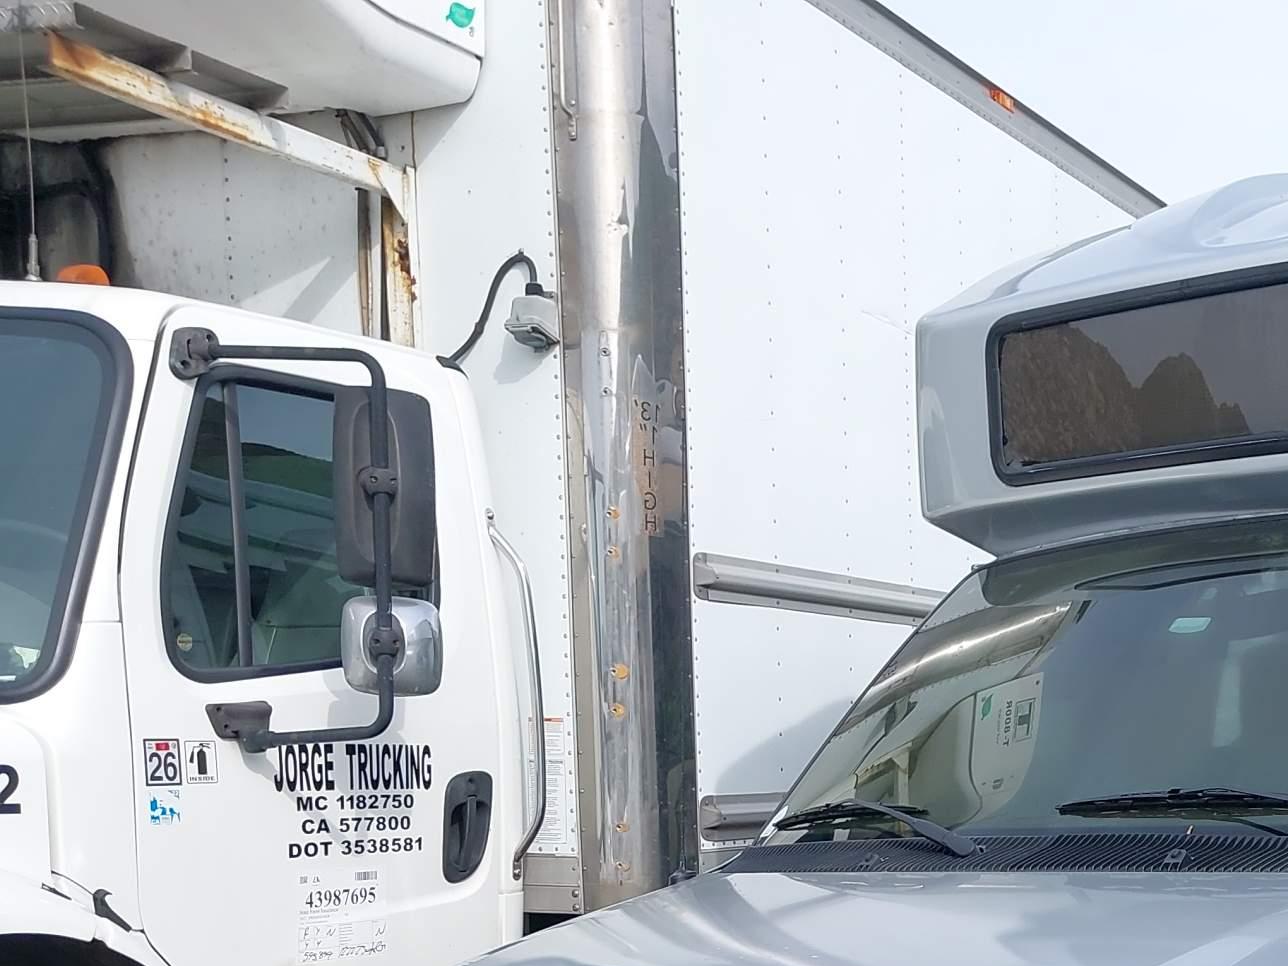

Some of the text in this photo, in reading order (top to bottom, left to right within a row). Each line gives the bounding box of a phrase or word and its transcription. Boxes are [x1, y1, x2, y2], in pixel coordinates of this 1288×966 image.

[148, 751, 178, 782] 26
[273, 743, 432, 792] JORGE TRUCKING
[296, 794, 414, 812] MC 1182750
[301, 815, 411, 834] CA 577800
[288, 836, 423, 859] DOT 3538581
[305, 886, 376, 908] 43987695
